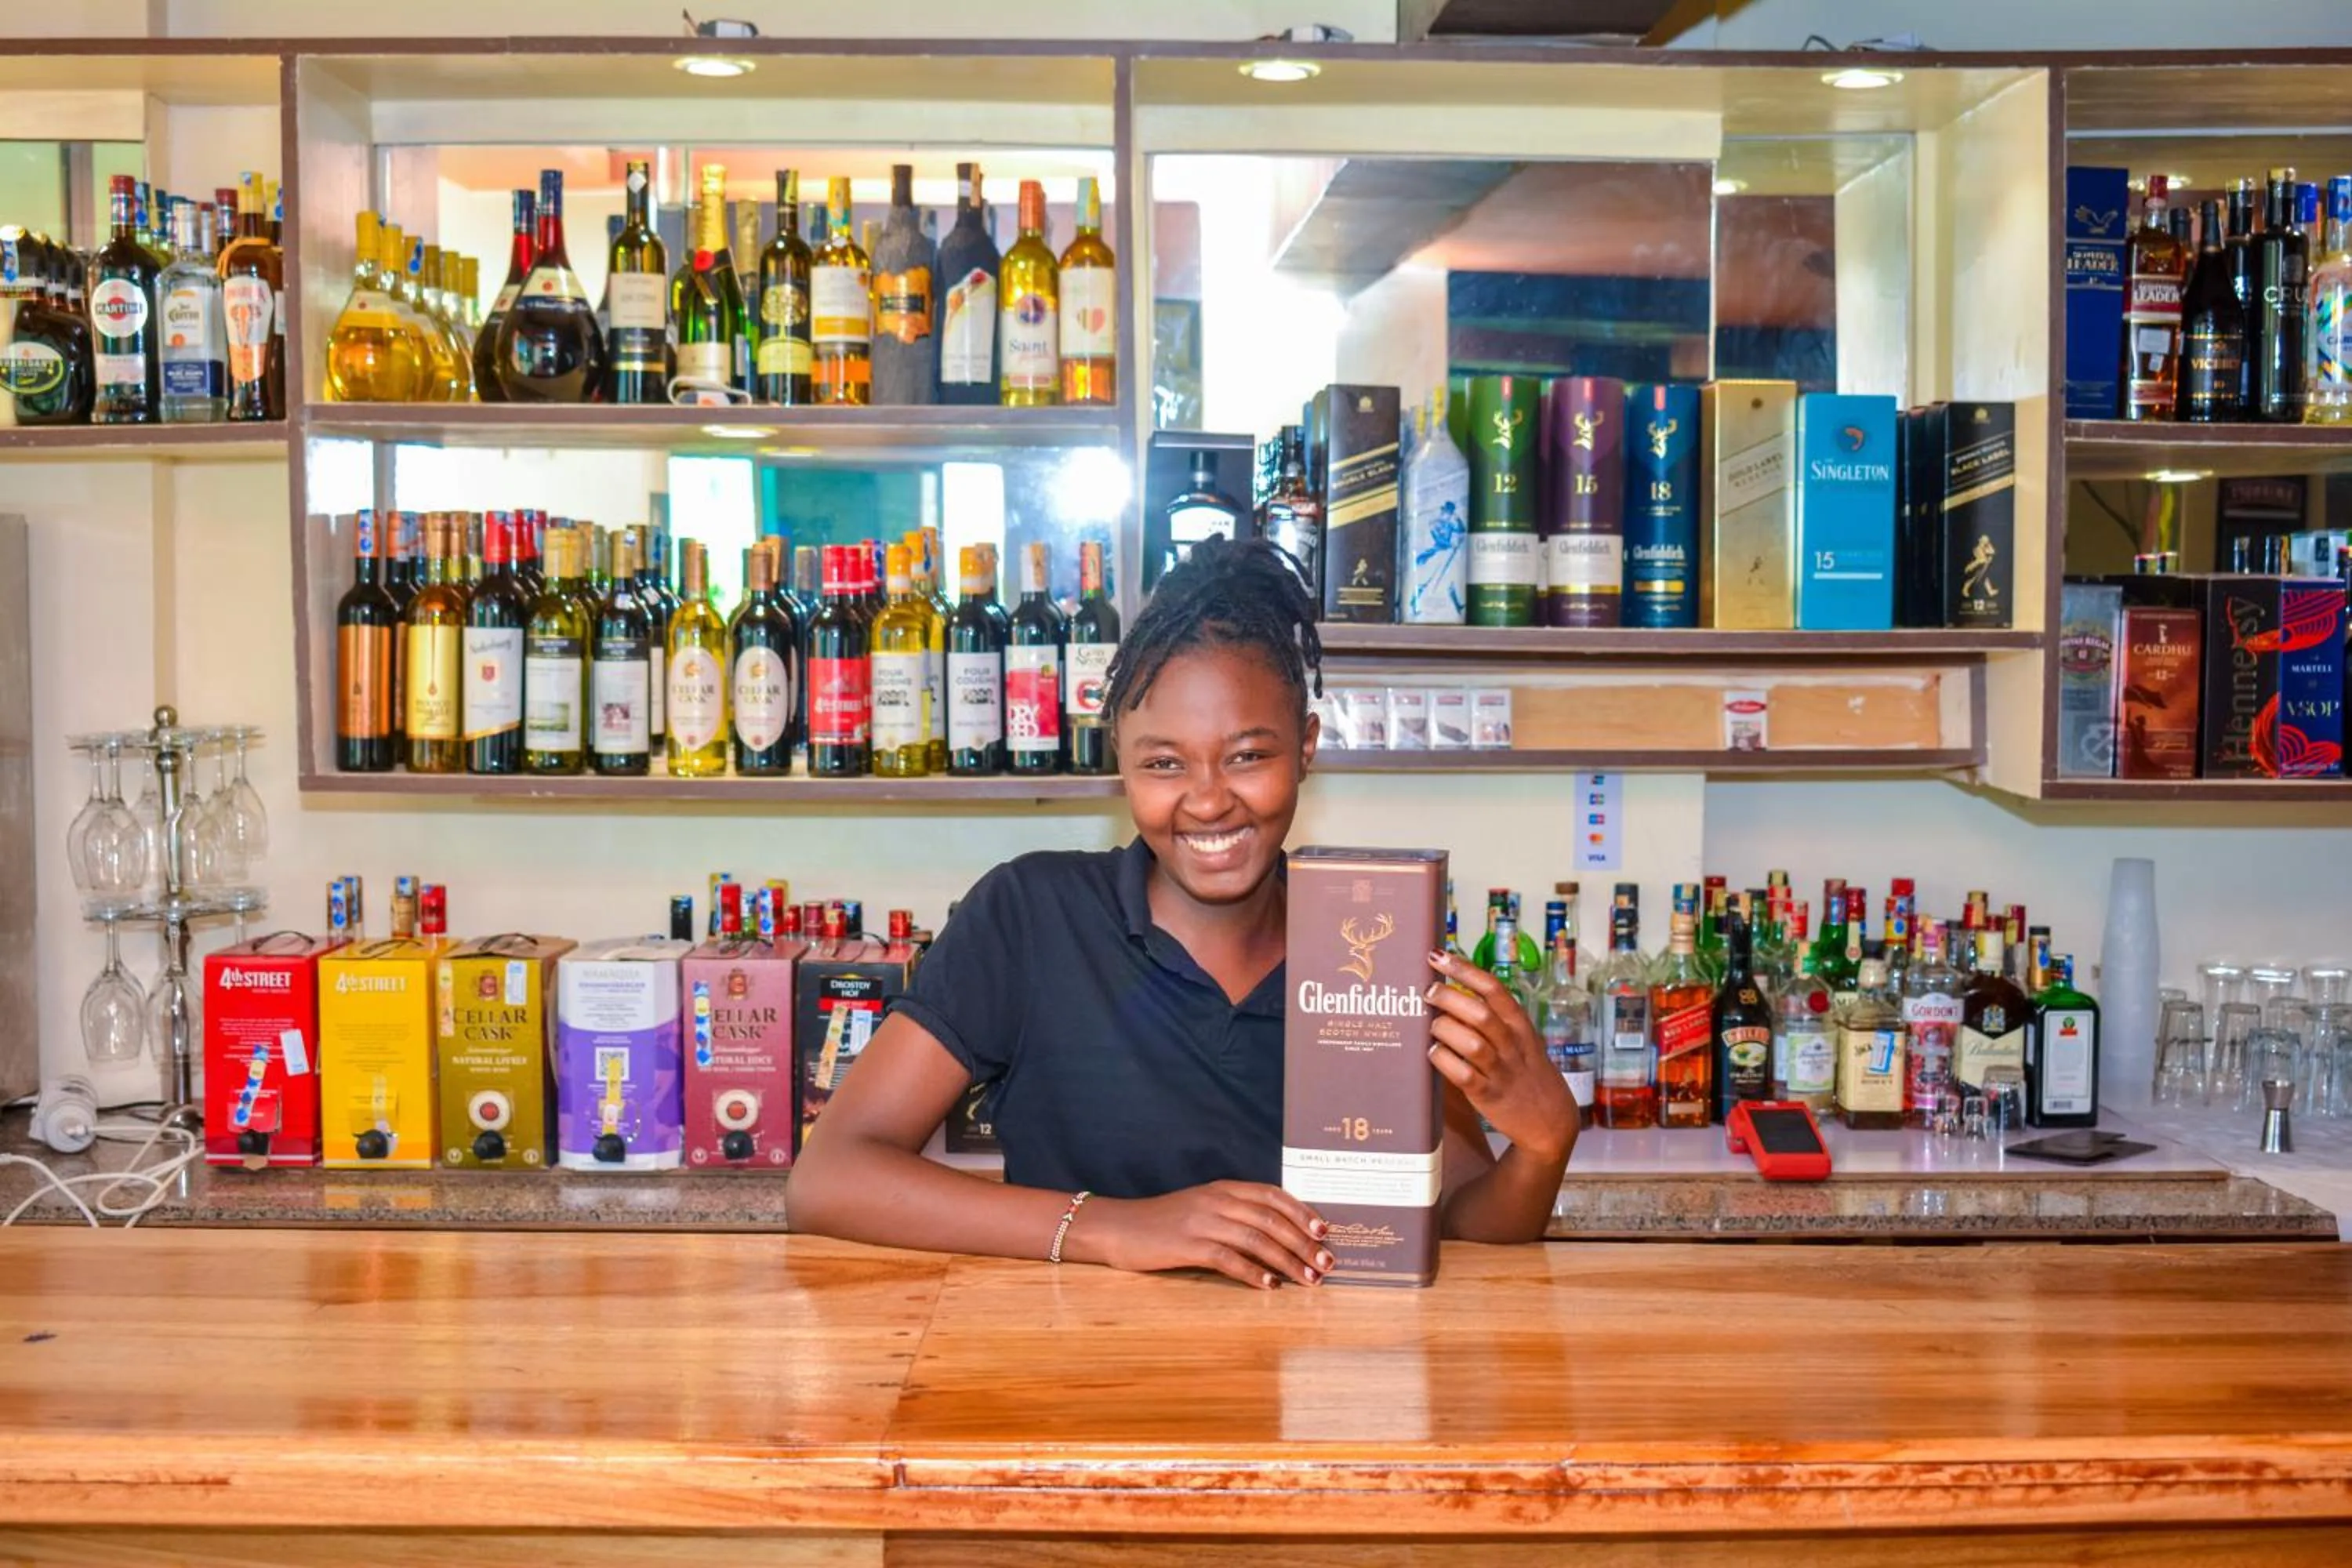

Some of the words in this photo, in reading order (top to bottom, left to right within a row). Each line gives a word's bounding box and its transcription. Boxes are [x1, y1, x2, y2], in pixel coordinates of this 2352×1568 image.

[1810, 459, 1890, 481] SINGLETON
[1492, 473, 1518, 494] 12
[1573, 474, 1599, 495] 15
[1650, 481, 1672, 501] 18
[1813, 550, 1835, 570] 15
[2132, 643, 2192, 656] CARDHU
[2222, 594, 2267, 762] Hennesy
[244, 971, 292, 989] STREET
[360, 975, 407, 992] STREET
[1298, 979, 1423, 1017] Glenfiddich
[452, 1007, 528, 1024] CELLAR
[713, 1007, 778, 1023] ELLAR
[464, 1025, 513, 1041] CASK
[712, 1025, 761, 1040] CASK
[979, 1123, 993, 1135] 12
[1341, 1117, 1370, 1142] 18
